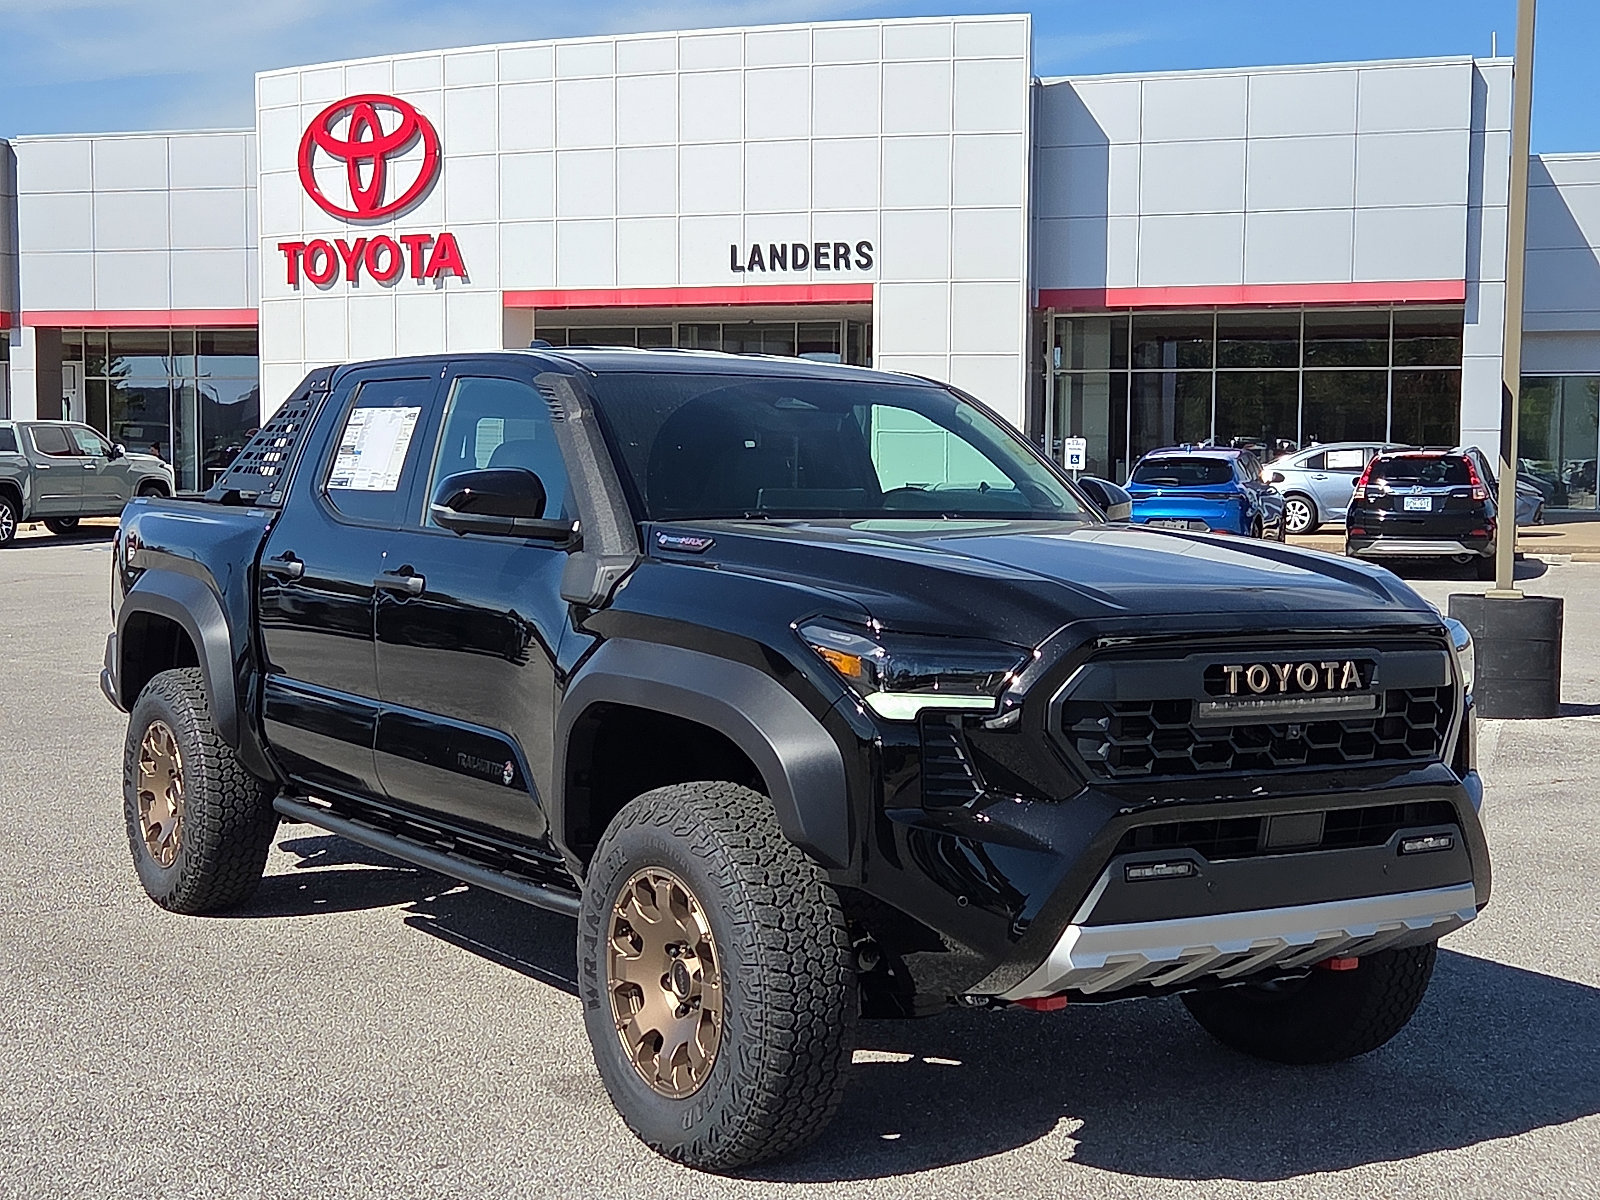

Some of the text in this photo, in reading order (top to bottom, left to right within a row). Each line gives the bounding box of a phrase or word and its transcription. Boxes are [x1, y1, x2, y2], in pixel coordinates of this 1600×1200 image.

[278, 232, 468, 286] TOYOTA
[730, 241, 874, 272] LANDERS
[1224, 661, 1362, 694] TOYOTA
[584, 846, 629, 1011] WRANGLER
